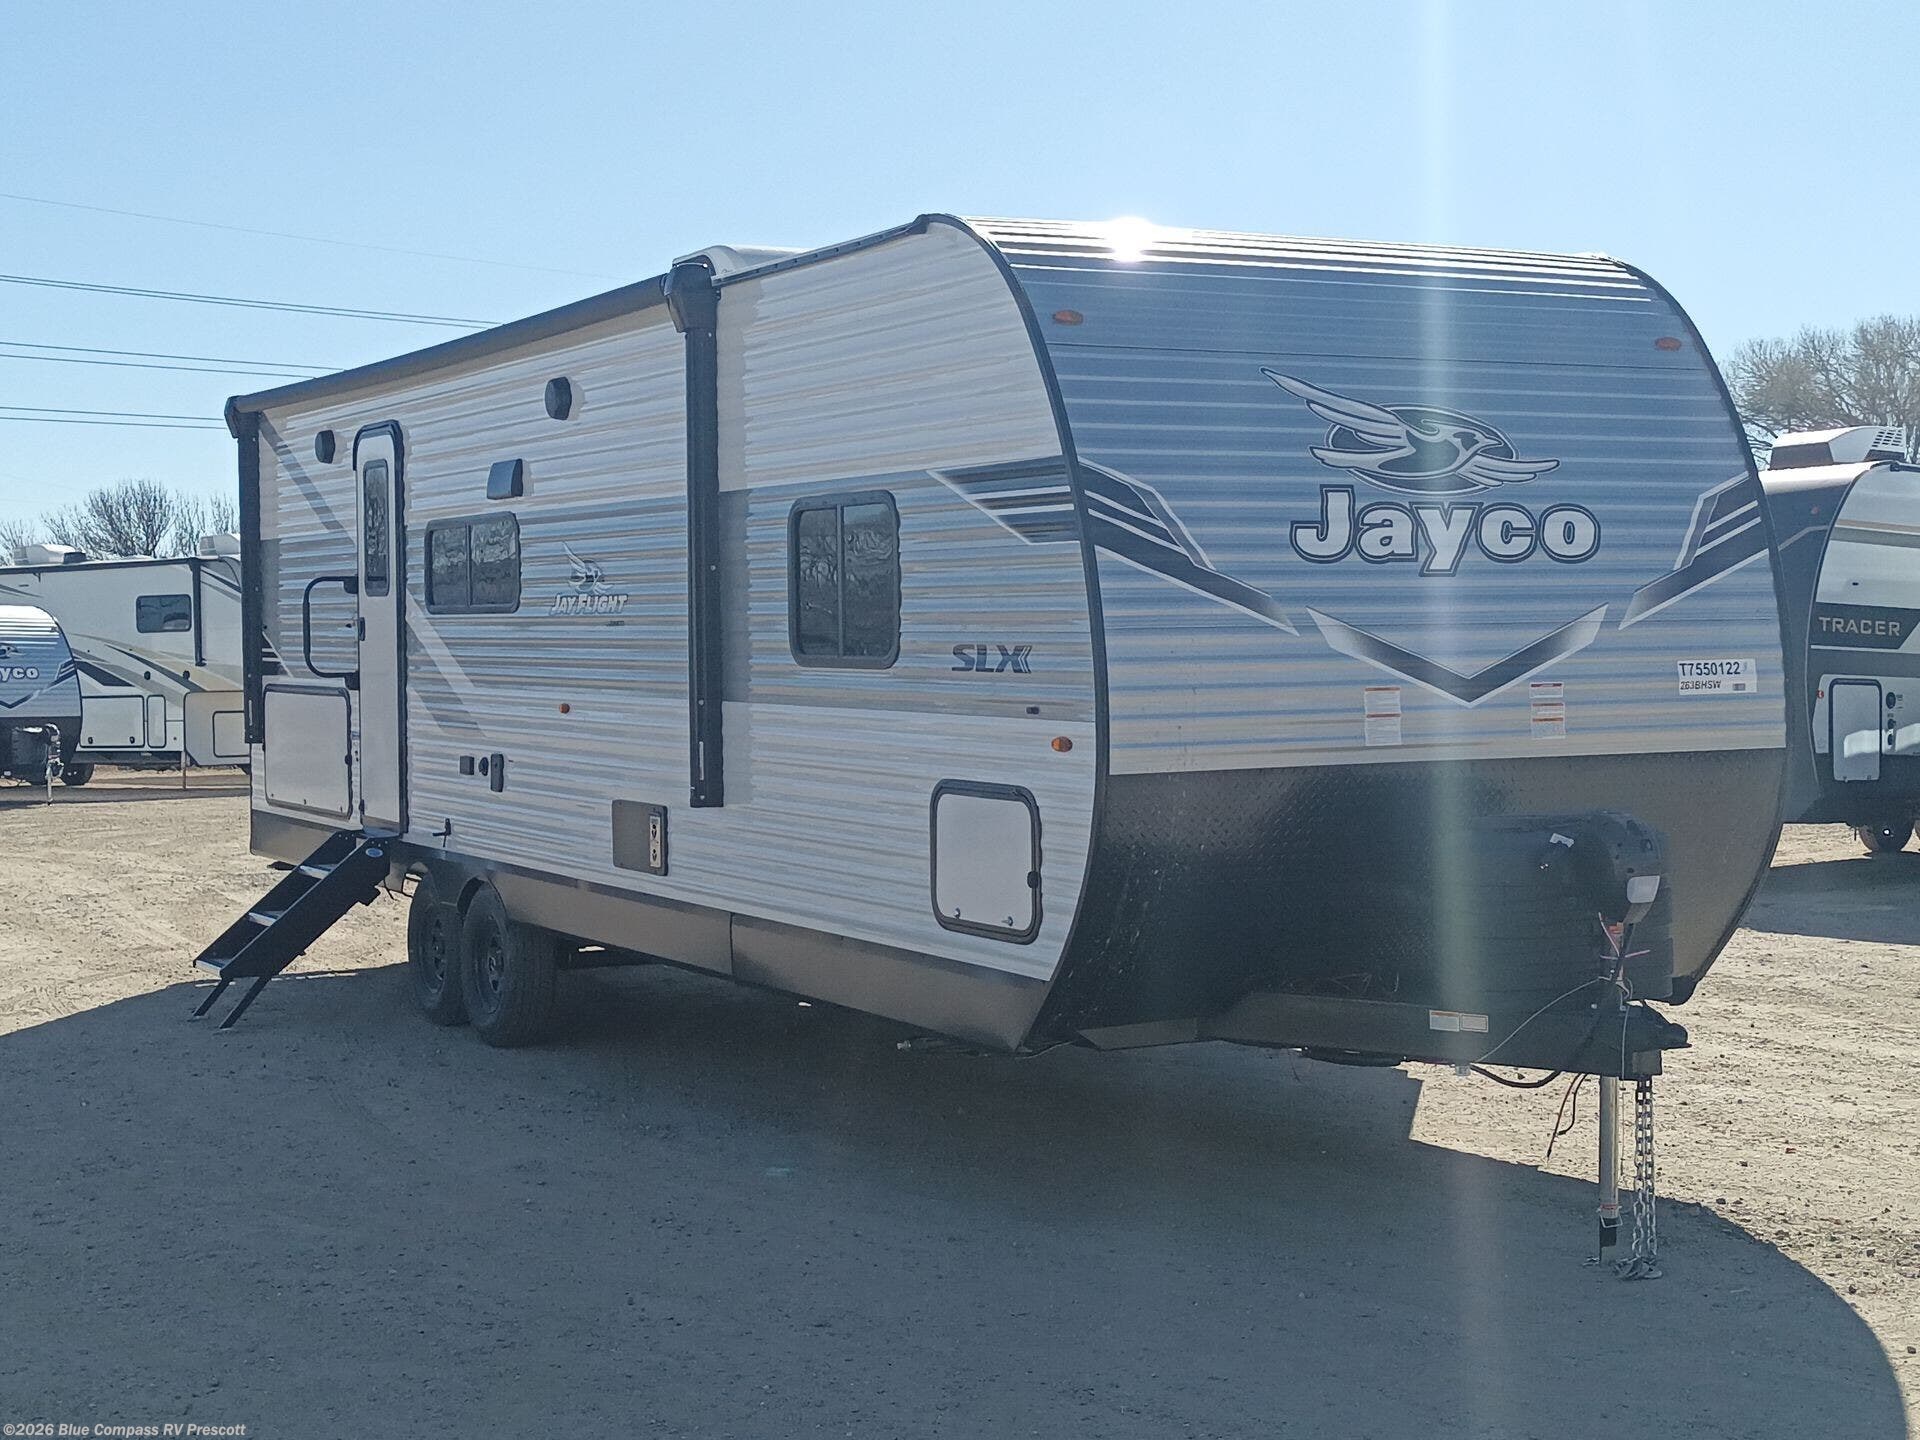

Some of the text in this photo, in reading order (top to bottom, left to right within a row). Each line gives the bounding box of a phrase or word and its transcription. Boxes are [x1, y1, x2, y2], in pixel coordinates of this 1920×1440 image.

[1290, 485, 1600, 577] Jayco
[550, 593, 628, 615] JAY FLIGHT
[1818, 616, 1901, 637] TRACER
[951, 644, 1032, 674] SLX
[1679, 661, 1741, 676] T7550122
[0, 666, 39, 683] yco
